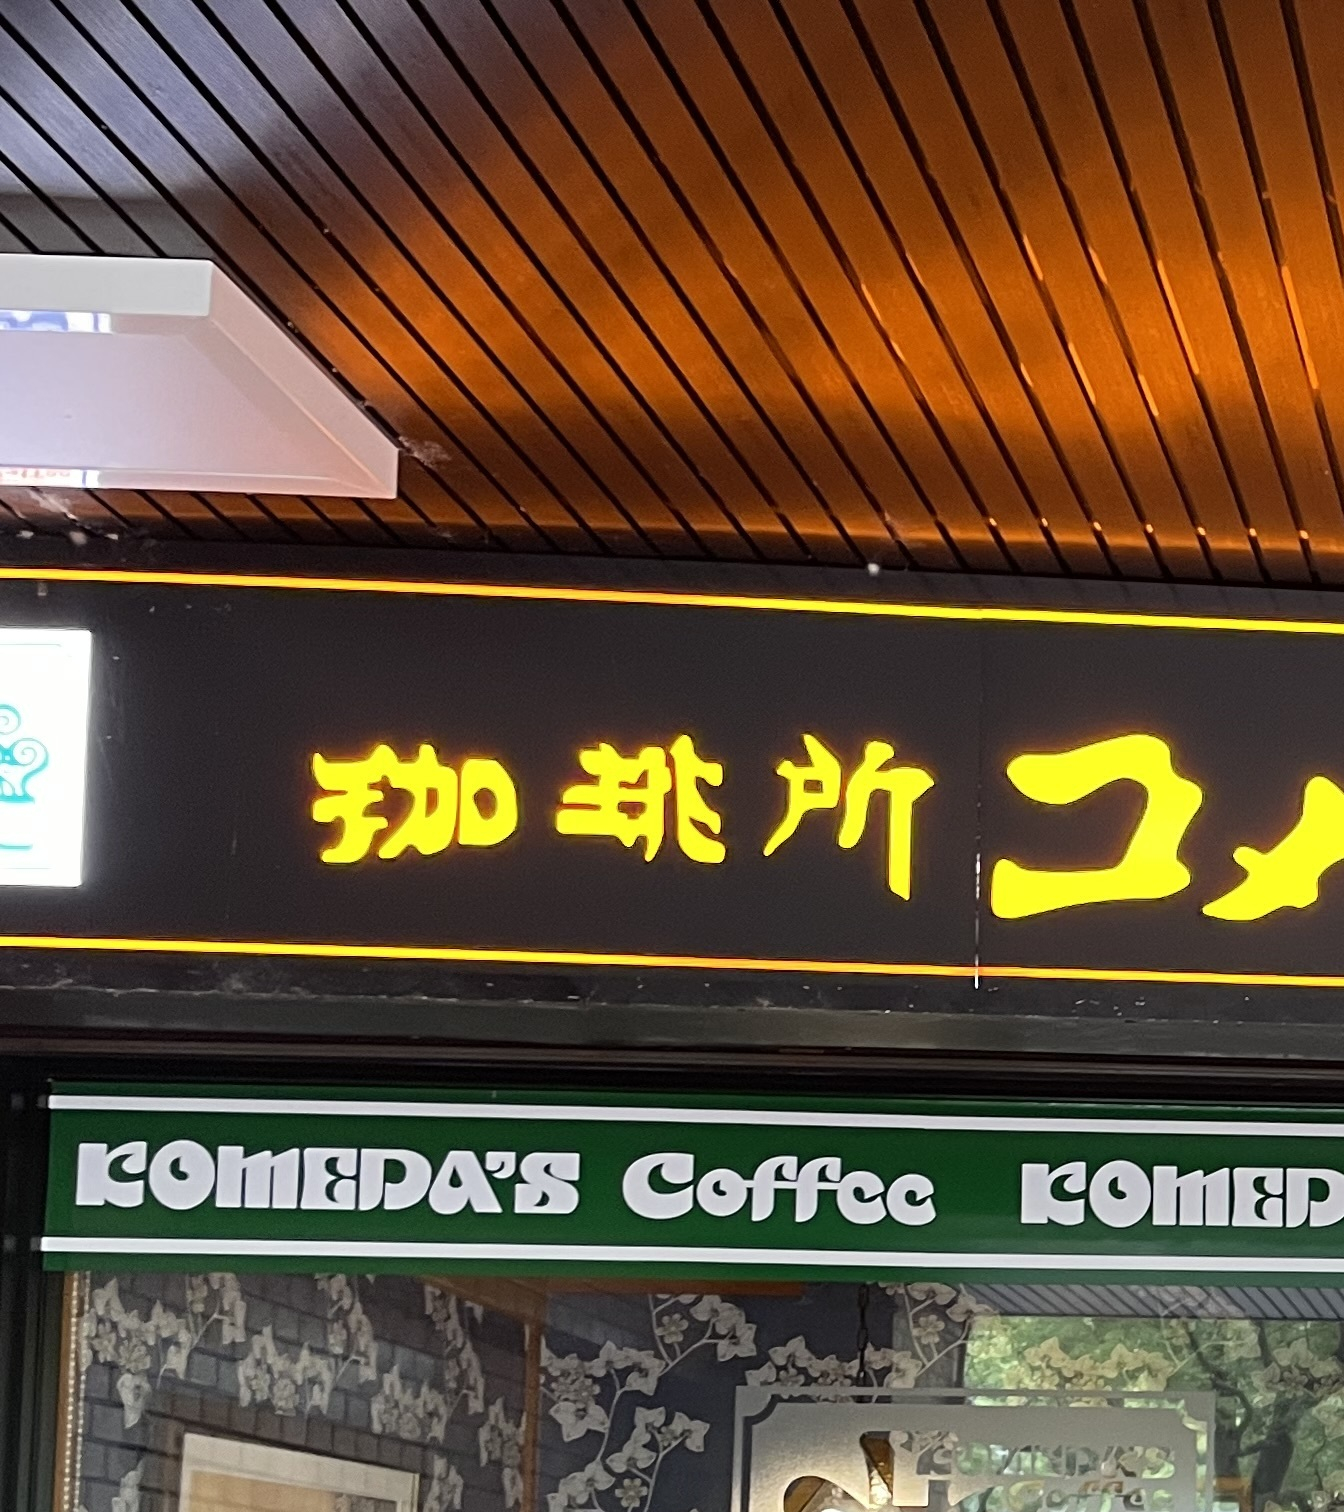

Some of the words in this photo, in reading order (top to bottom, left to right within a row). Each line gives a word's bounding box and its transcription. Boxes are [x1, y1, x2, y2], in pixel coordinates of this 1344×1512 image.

[313, 735, 934, 899] 珈琲所
[75, 1140, 580, 1215] KOMEDA'S
[622, 1152, 936, 1226] Coffee
